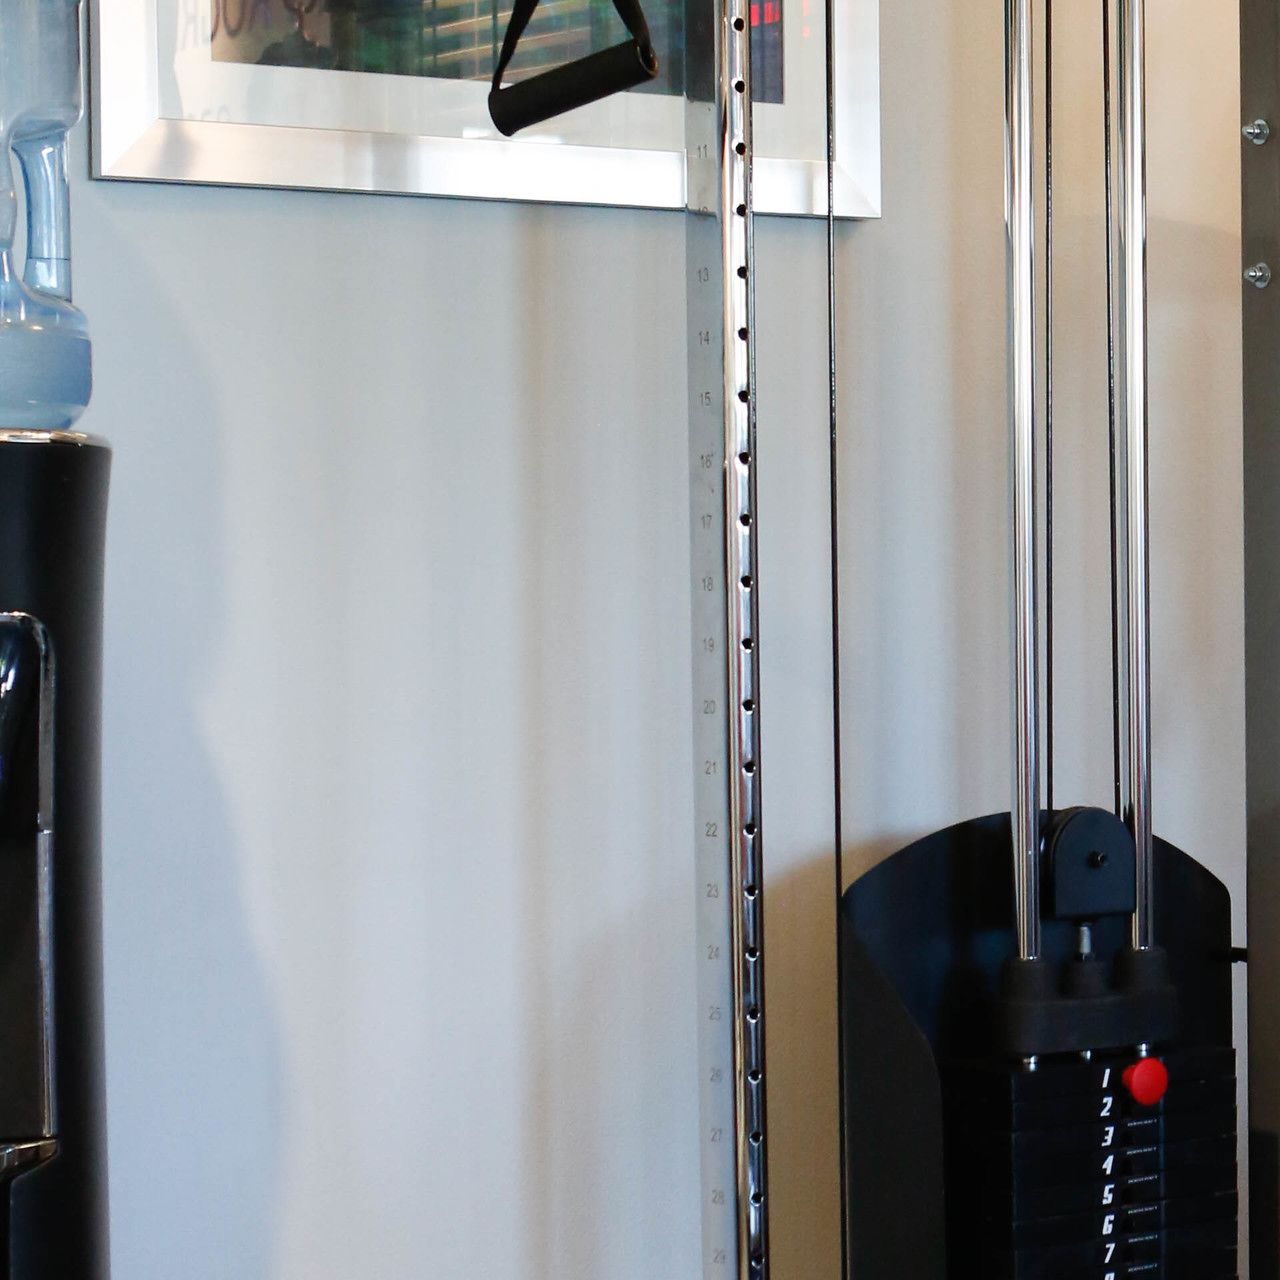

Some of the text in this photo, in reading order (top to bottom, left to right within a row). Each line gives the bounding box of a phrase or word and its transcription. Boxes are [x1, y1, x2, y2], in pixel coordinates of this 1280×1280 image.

[1102, 1068, 1111, 1088] 1
[1100, 1096, 1113, 1117] 2
[1101, 1126, 1114, 1147] 3
[1102, 1155, 1114, 1175] 4
[1102, 1184, 1115, 1205] 5
[1102, 1214, 1115, 1235] 6
[1104, 1243, 1115, 1264] 7
